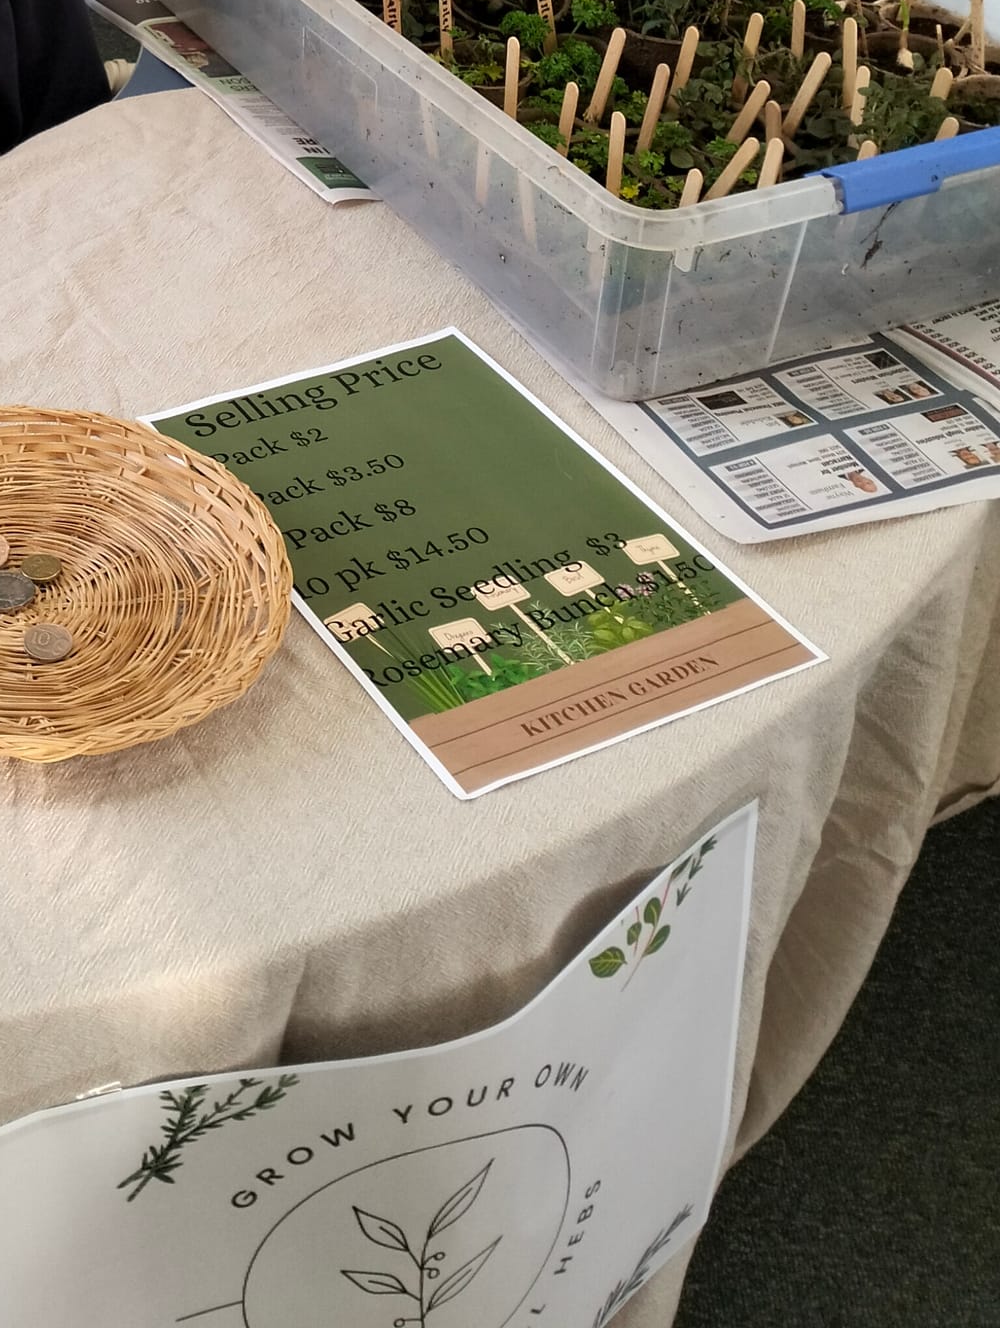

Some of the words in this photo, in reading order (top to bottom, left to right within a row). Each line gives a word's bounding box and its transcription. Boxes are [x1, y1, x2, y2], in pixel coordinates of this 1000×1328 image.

[184, 385, 338, 438] Selling
[329, 353, 443, 396] Price
[290, 427, 329, 448] $2
[326, 454, 405, 487] $3.50
[283, 510, 374, 551] Pack
[374, 499, 417, 523] $8
[335, 557, 387, 593] pk
[386, 527, 489, 571] $14.50
[325, 599, 430, 644] Garlic
[430, 549, 583, 609] Seedling
[586, 532, 627, 557] $3
[525, 582, 637, 632] Bunch
[636, 554, 716, 593] $1.50
[520, 686, 627, 737] KITCHEN
[628, 653, 719, 698] GARDEN
[232, 1122, 357, 1210] GROW
[393, 1076, 515, 1126] YOUR
[534, 1059, 591, 1094] OWN
[554, 1179, 601, 1275] HEBS
